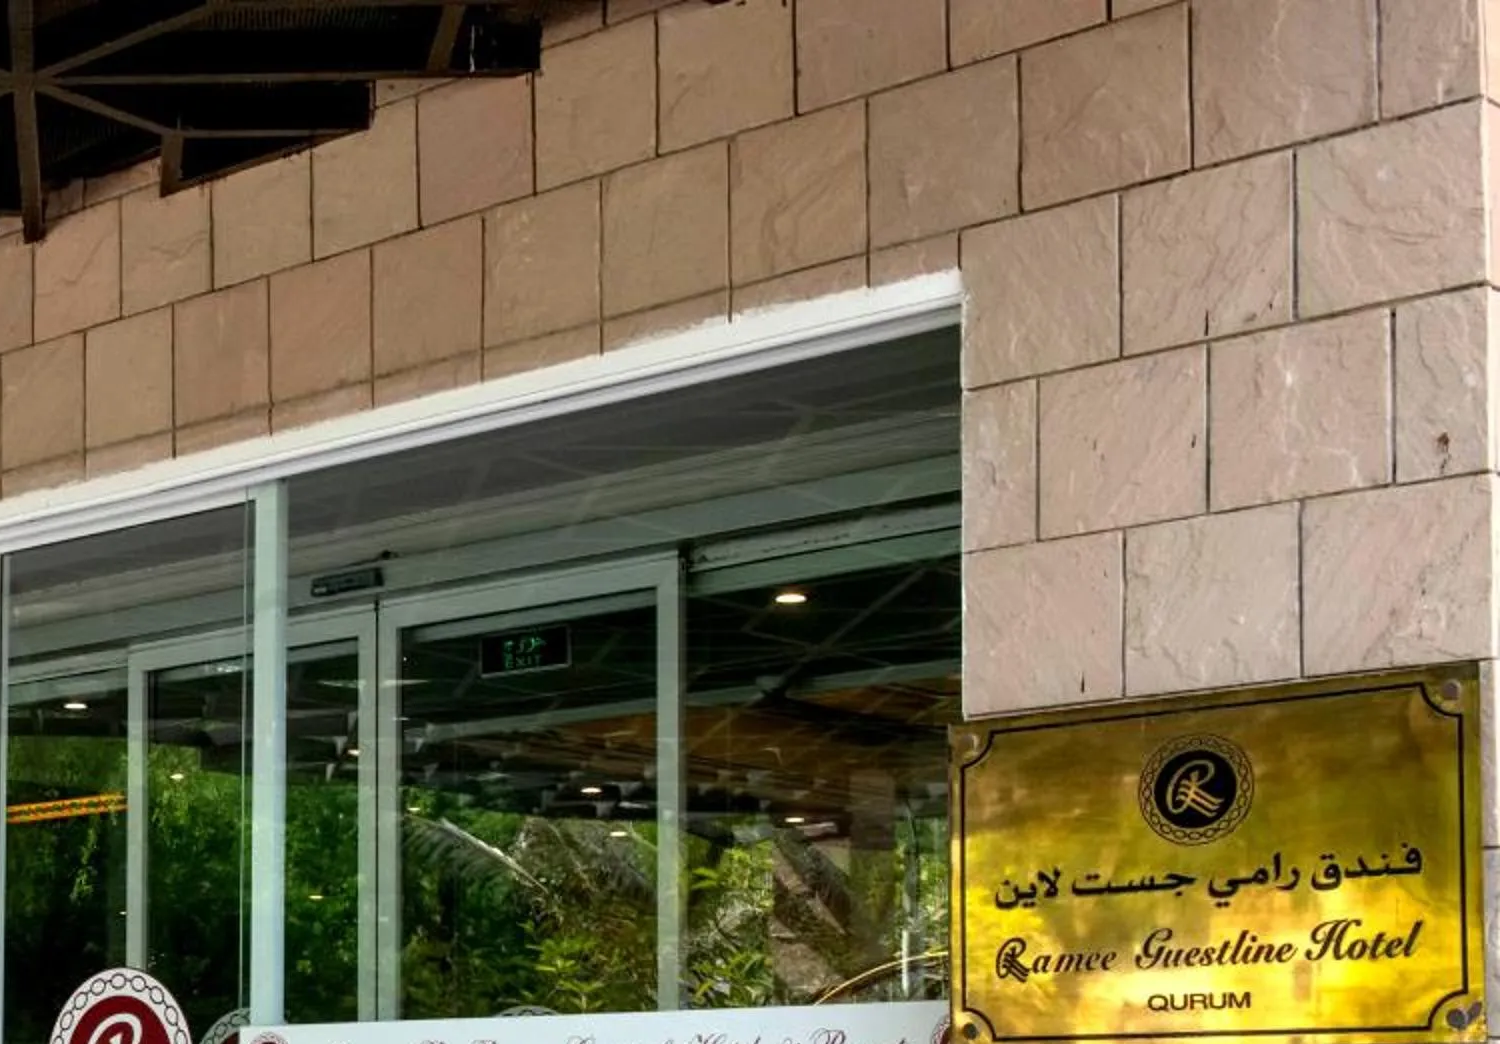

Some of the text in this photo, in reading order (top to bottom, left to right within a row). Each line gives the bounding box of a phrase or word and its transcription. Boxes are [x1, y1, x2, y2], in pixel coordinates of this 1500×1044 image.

[505, 653, 542, 669] EXIT
[995, 842, 1423, 910] فندق رامي جست لاين
[995, 918, 1424, 983] Ramee Guestline Hotel
[1147, 992, 1252, 1012] QURUM
